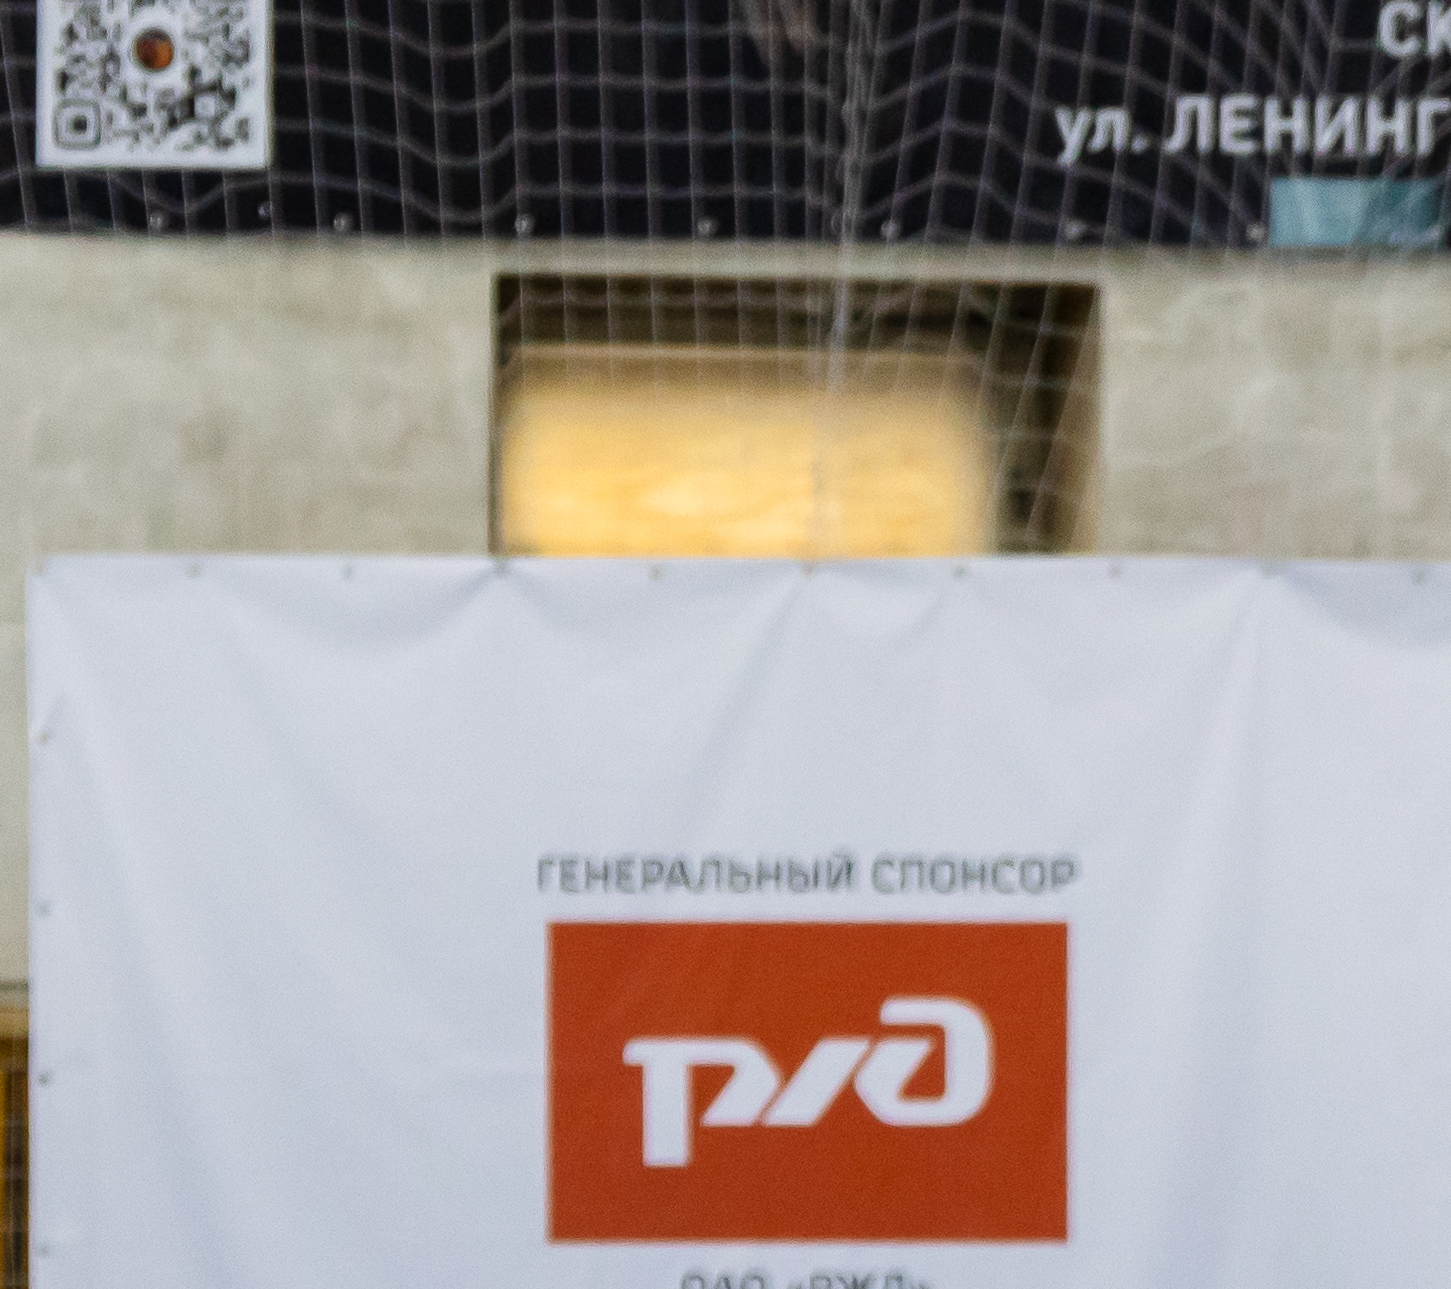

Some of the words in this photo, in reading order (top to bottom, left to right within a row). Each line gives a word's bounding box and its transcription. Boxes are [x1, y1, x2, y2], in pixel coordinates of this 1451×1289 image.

[1054, 105, 1150, 166] ул.
[536, 845, 854, 895] ГЕНЕРАЛЬНЫЙ
[869, 856, 1076, 895] СПОНСОР
